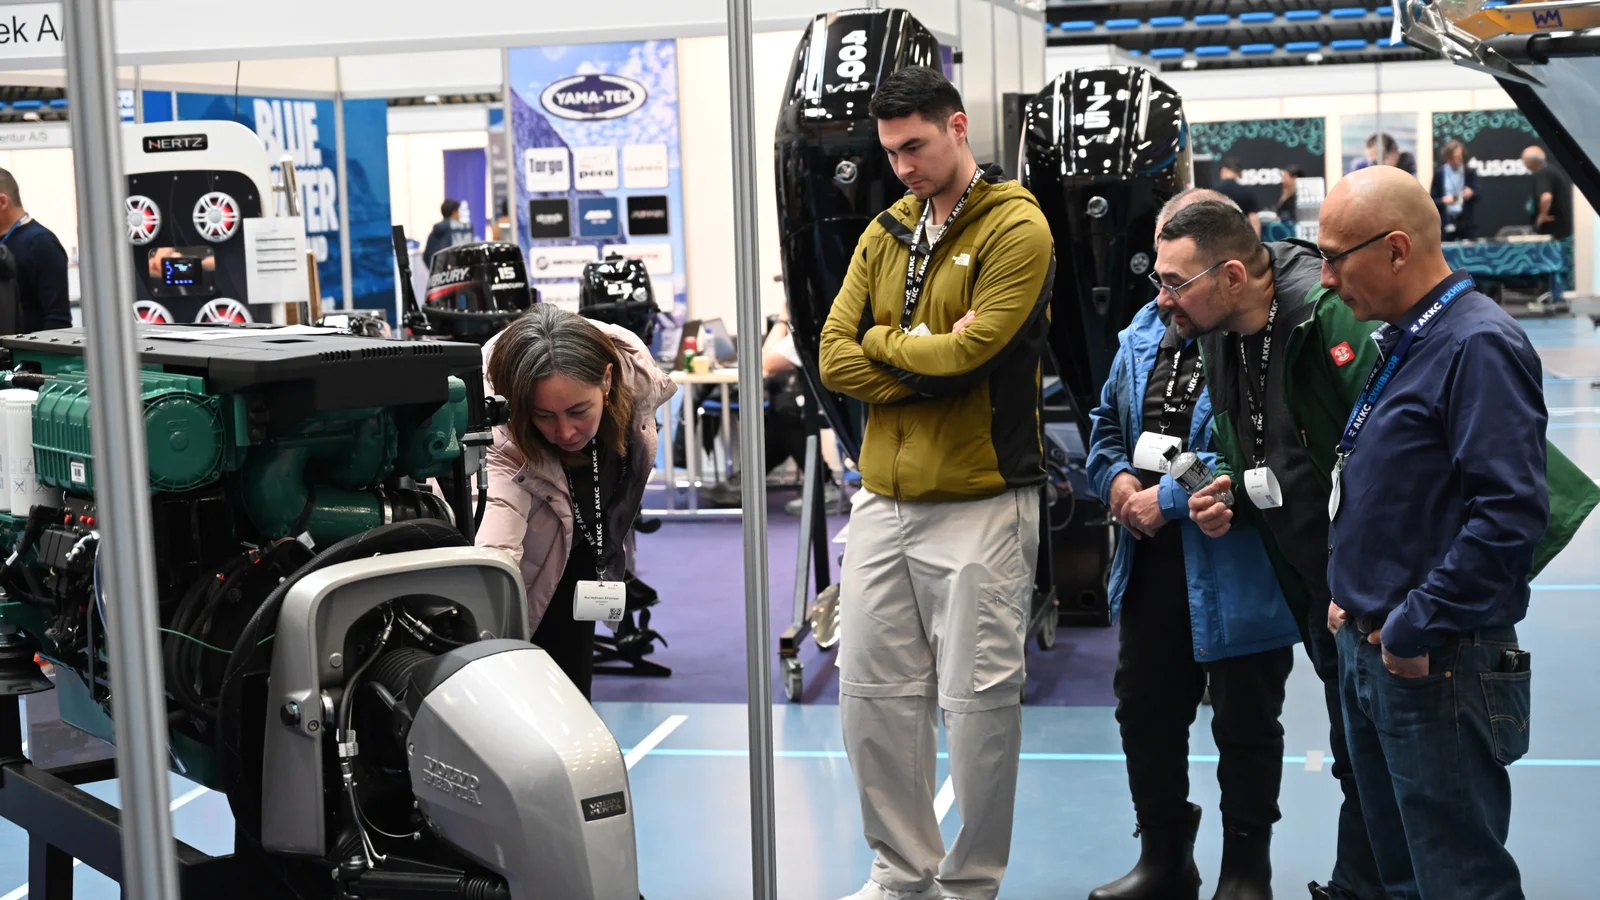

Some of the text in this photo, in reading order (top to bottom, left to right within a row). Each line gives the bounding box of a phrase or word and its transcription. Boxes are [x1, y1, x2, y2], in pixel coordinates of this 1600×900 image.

[148, 137, 203, 149] HERTZ
[253, 99, 323, 166] BLUE
[952, 197, 968, 217] AKKC
[498, 266, 516, 280] 15
[907, 256, 916, 278] AKKC
[918, 254, 930, 276] AKKC
[910, 287, 920, 303] KKC
[1418, 302, 1442, 327] AKKC
[1261, 336, 1272, 361] AKKC
[1166, 380, 1175, 396] KKC
[1187, 372, 1200, 393] AKKC
[1354, 403, 1372, 430] AKKC
[1367, 355, 1400, 403] EXHIBITOR
[584, 531, 596, 546] KKC
